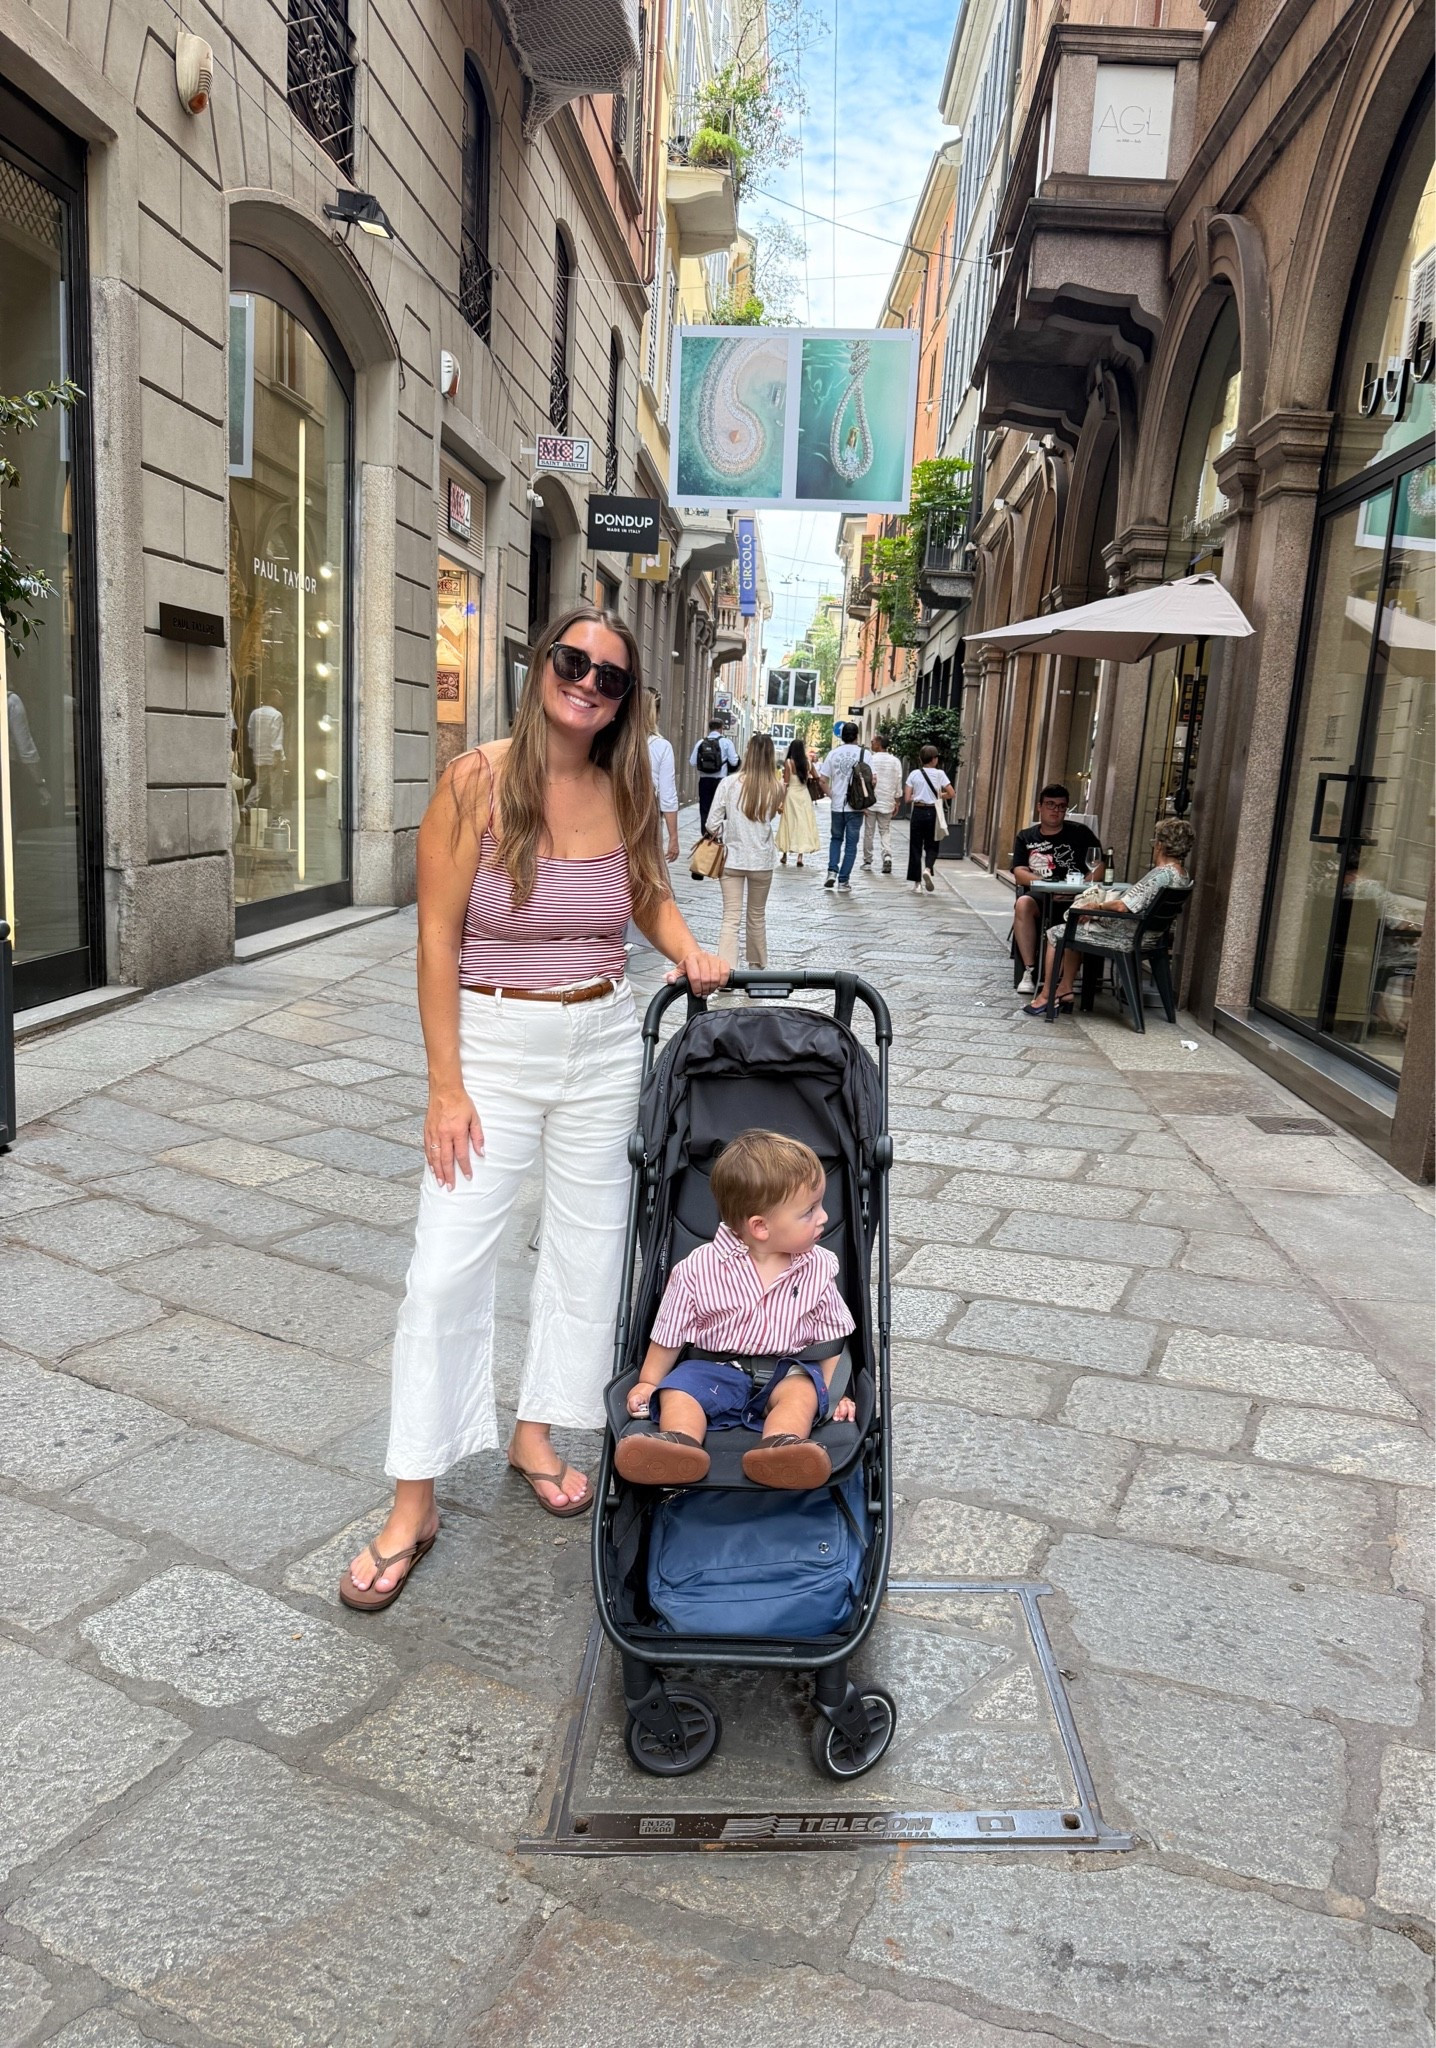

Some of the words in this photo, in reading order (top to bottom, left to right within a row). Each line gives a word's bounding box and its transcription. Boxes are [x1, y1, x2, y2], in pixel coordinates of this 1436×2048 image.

[1098, 105, 1161, 136] AGL
[595, 513, 653, 529] DONDUP
[254, 557, 280, 583] PAUL
[742, 534, 752, 590] CIRCOLO
[805, 1816, 933, 1832] TELECOM
